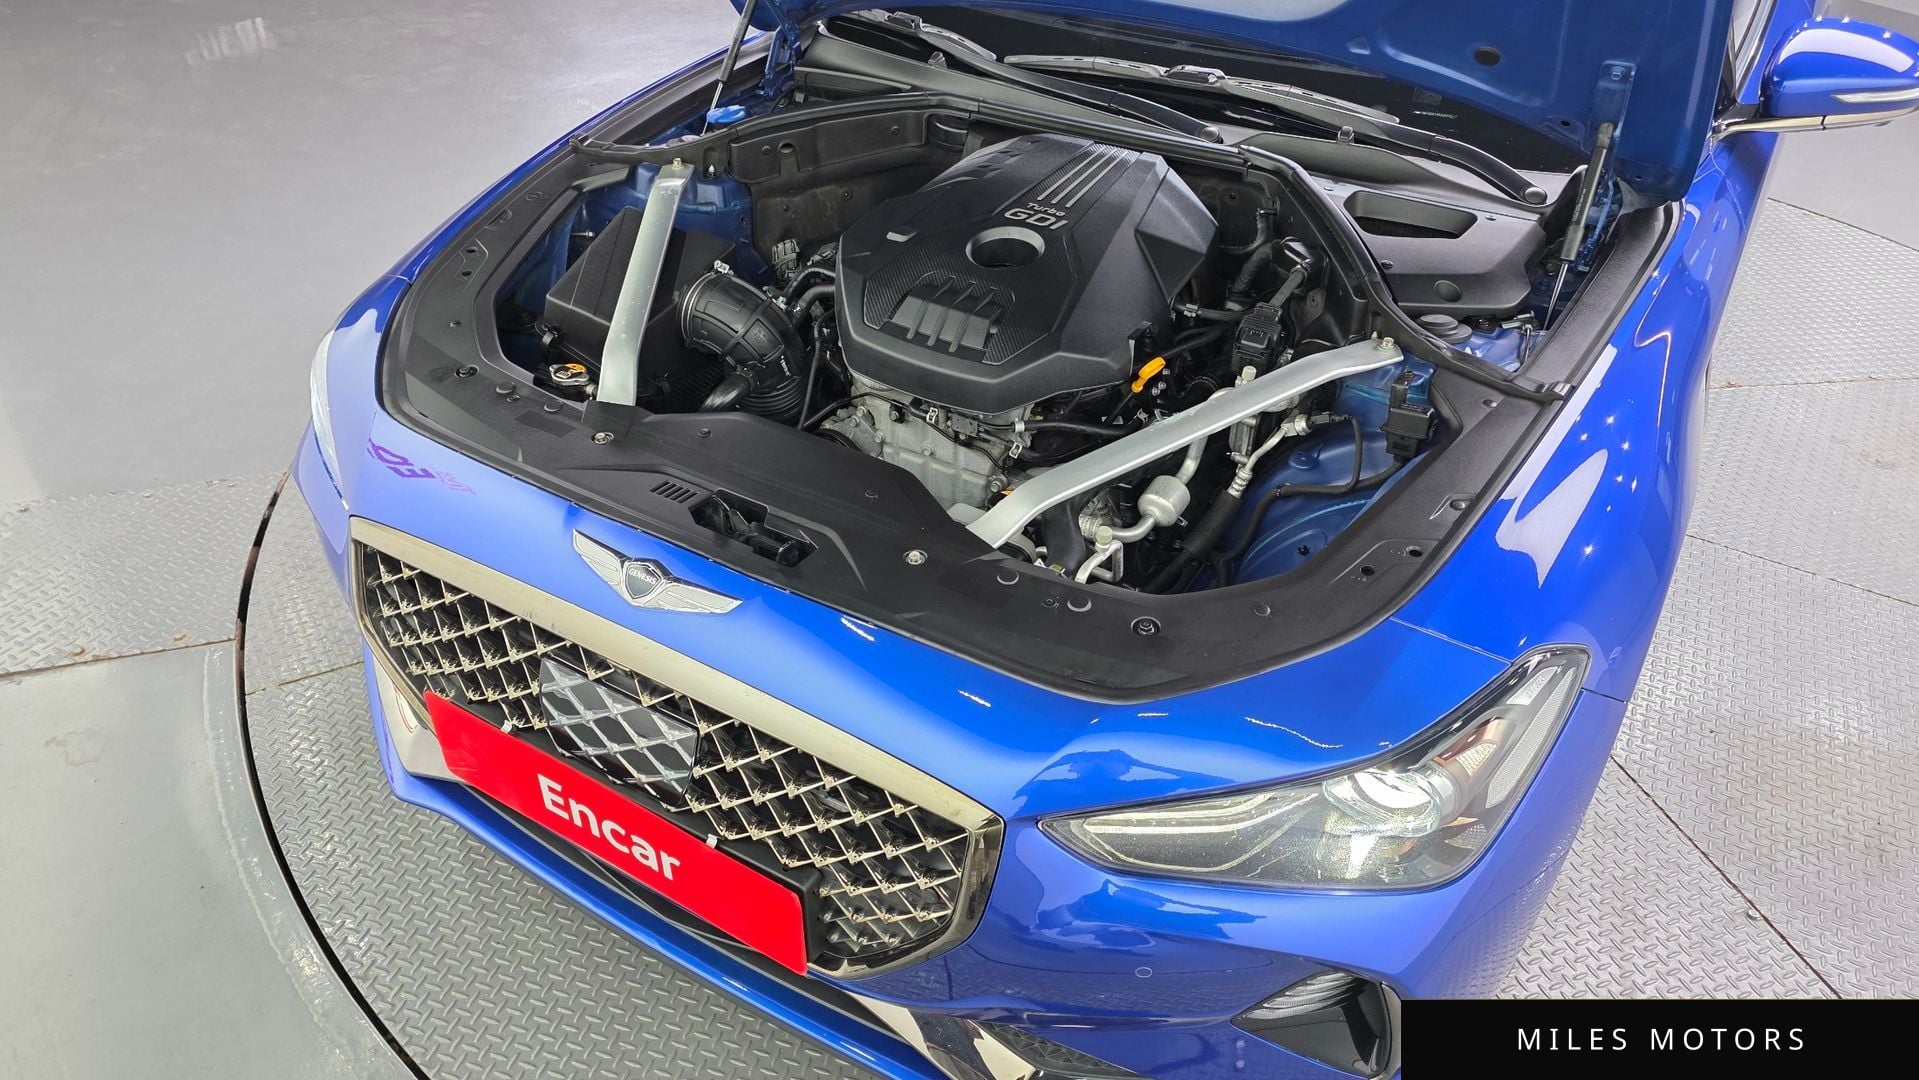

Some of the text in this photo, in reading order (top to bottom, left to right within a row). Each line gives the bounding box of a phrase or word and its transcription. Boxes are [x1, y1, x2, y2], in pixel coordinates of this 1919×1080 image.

[1027, 202, 1066, 217] Turbo
[628, 568, 658, 585] GENESIS
[537, 773, 681, 881] Encar
